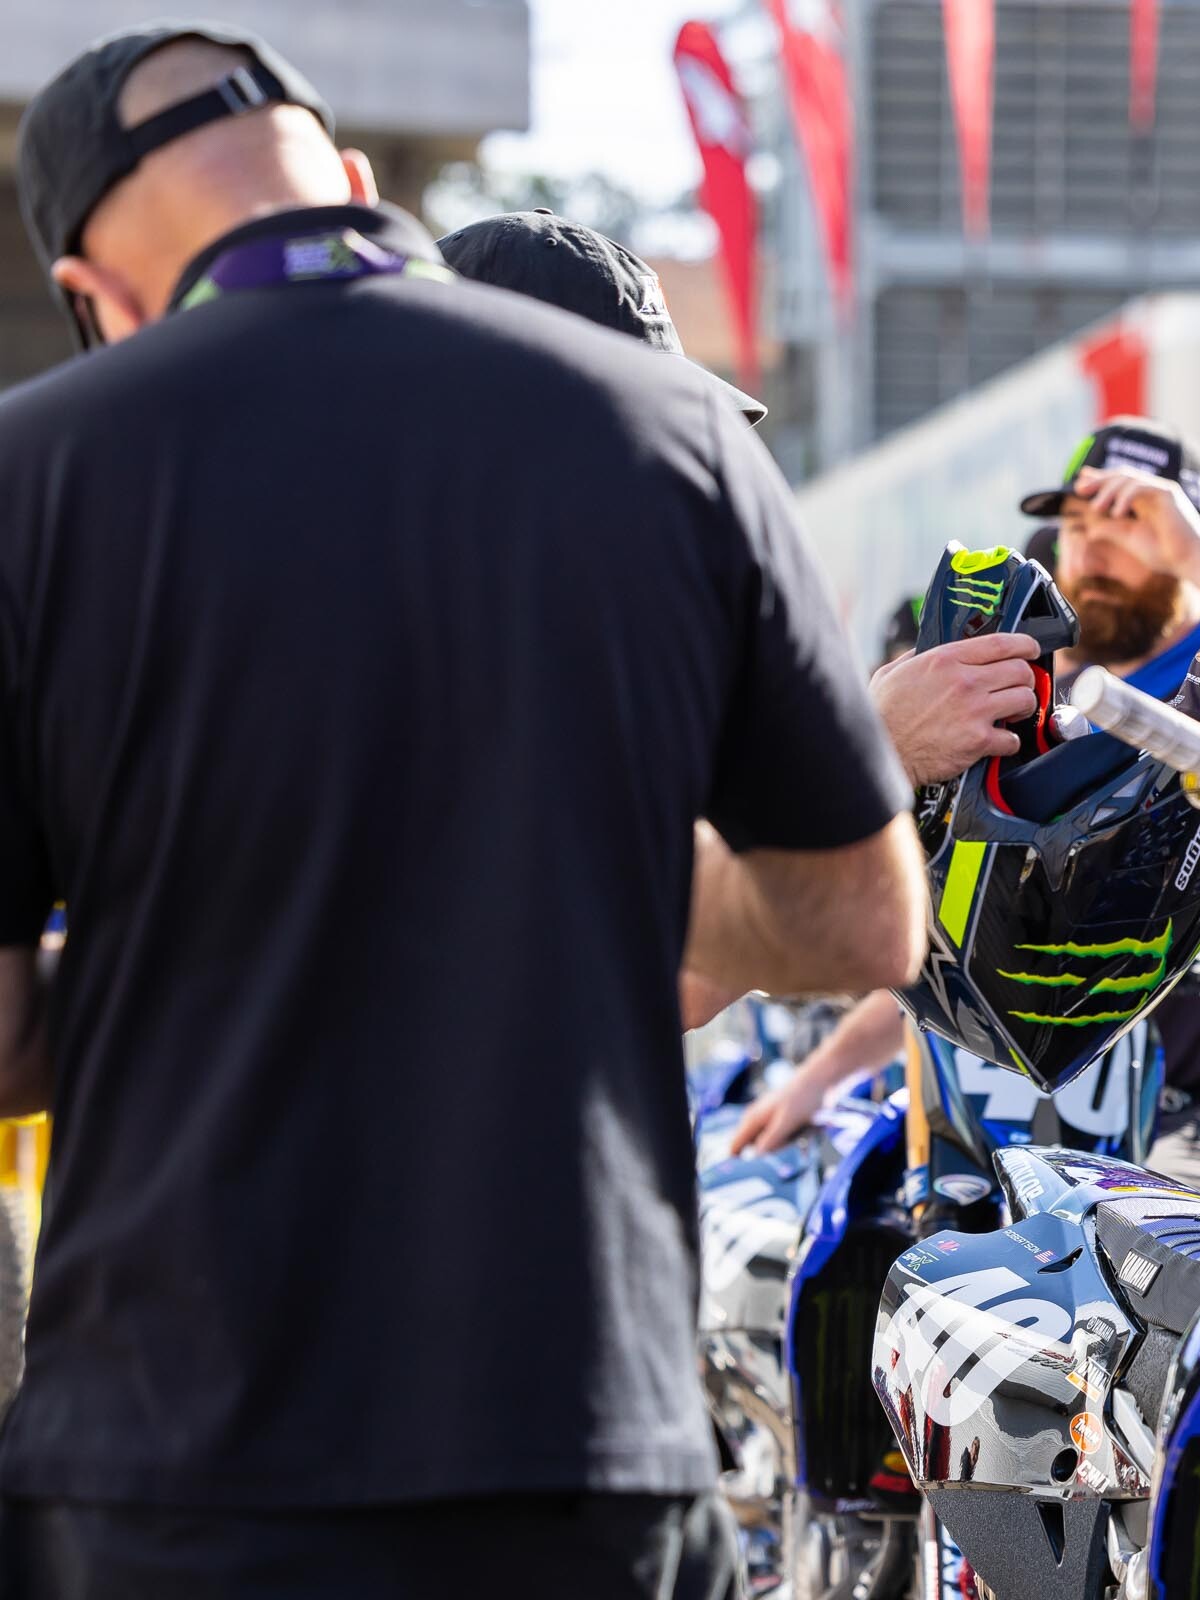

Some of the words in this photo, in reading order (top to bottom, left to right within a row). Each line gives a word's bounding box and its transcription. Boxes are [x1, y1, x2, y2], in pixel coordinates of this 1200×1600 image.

[1002, 1229, 1042, 1254] ROBERTSON
[1119, 1251, 1158, 1292] YAMAHA
[1092, 1318, 1115, 1343] YAMAHA
